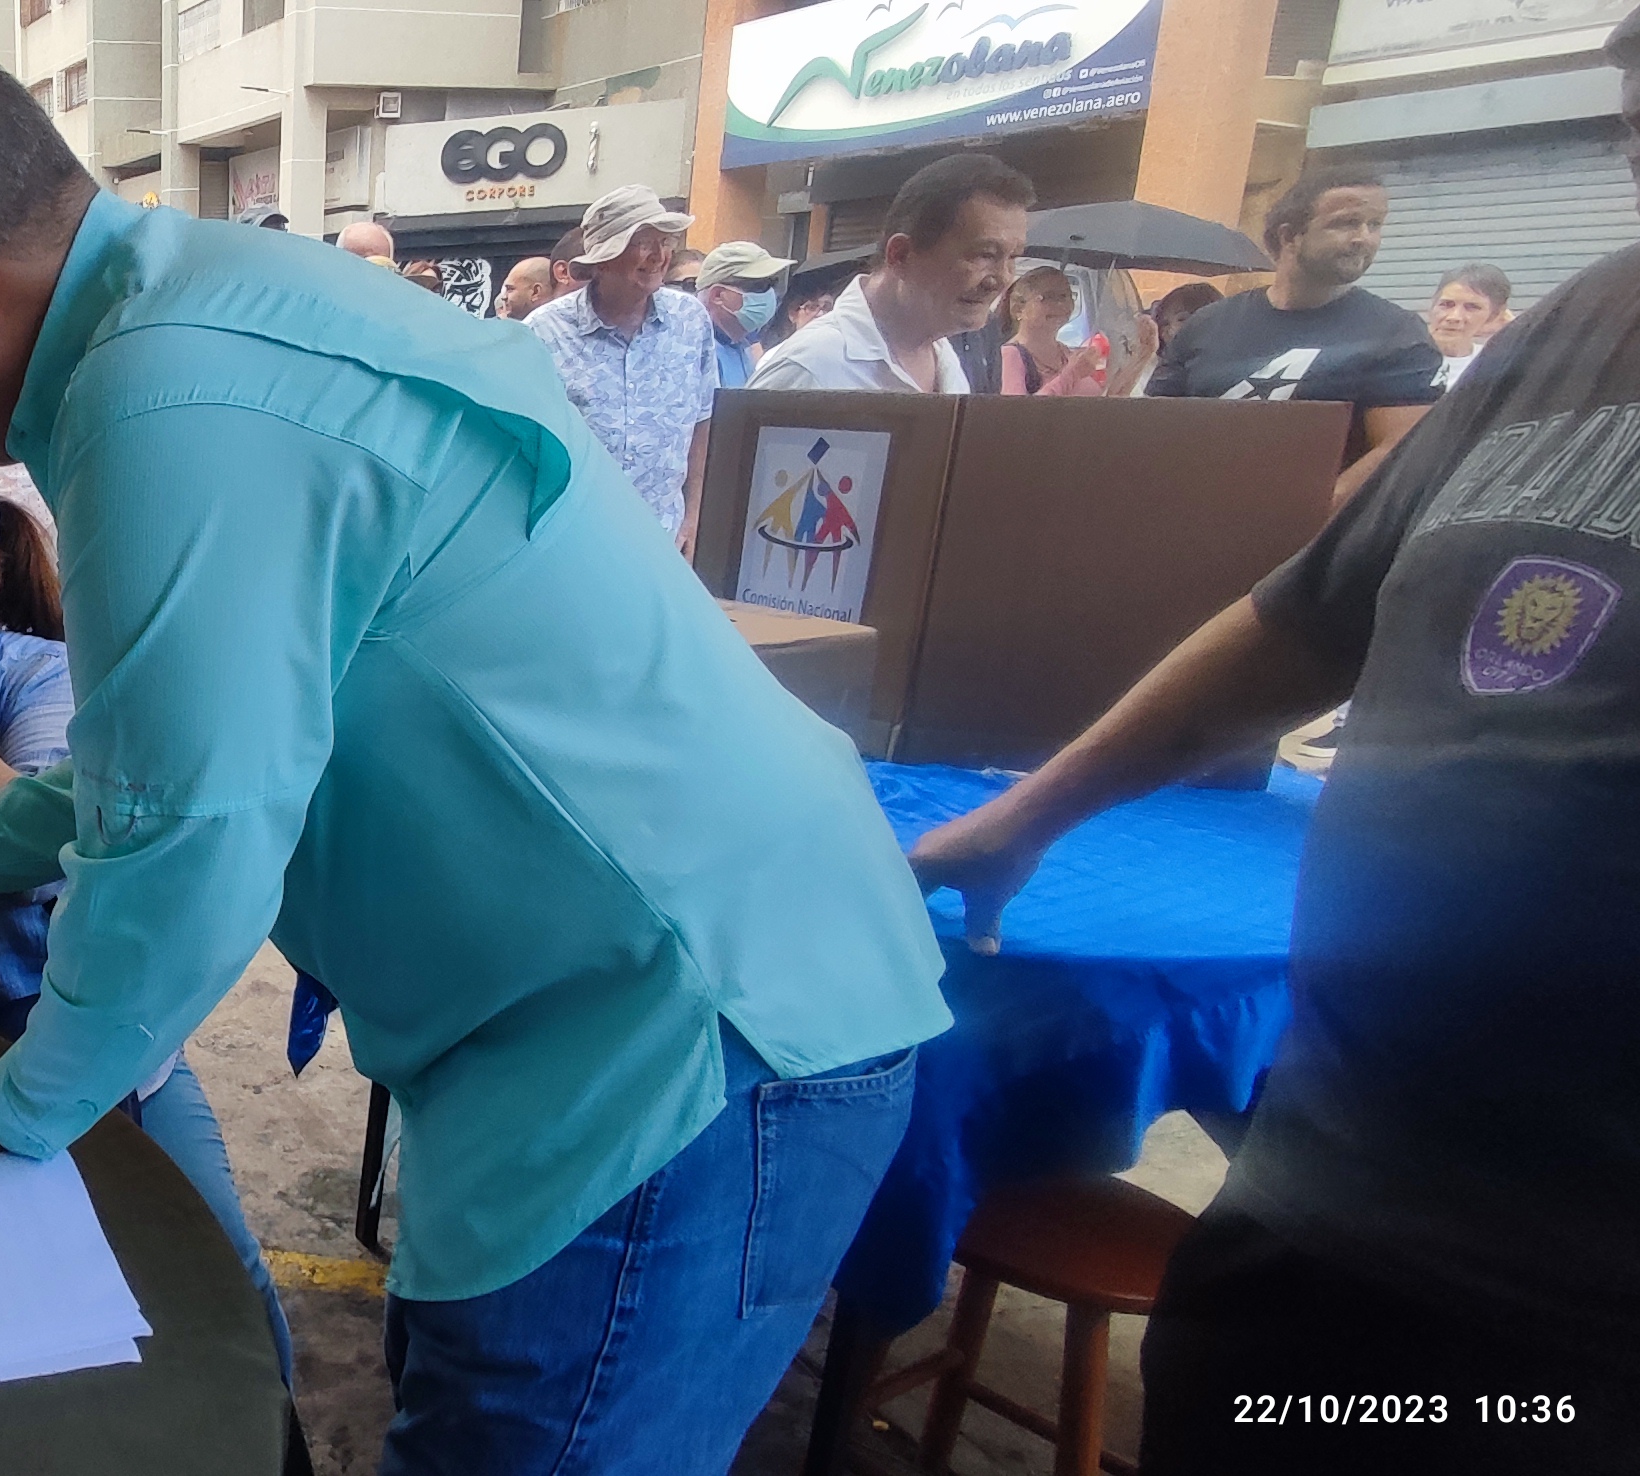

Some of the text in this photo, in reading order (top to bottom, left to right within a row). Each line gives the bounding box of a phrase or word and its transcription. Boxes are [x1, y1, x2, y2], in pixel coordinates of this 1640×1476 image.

[767, 3, 1073, 128] Venezolana
[985, 91, 1142, 127] www.venezolana.aero
[441, 122, 567, 184] EGO
[465, 185, 535, 202] CORPORE
[741, 588, 853, 623] Comisión Nacional
